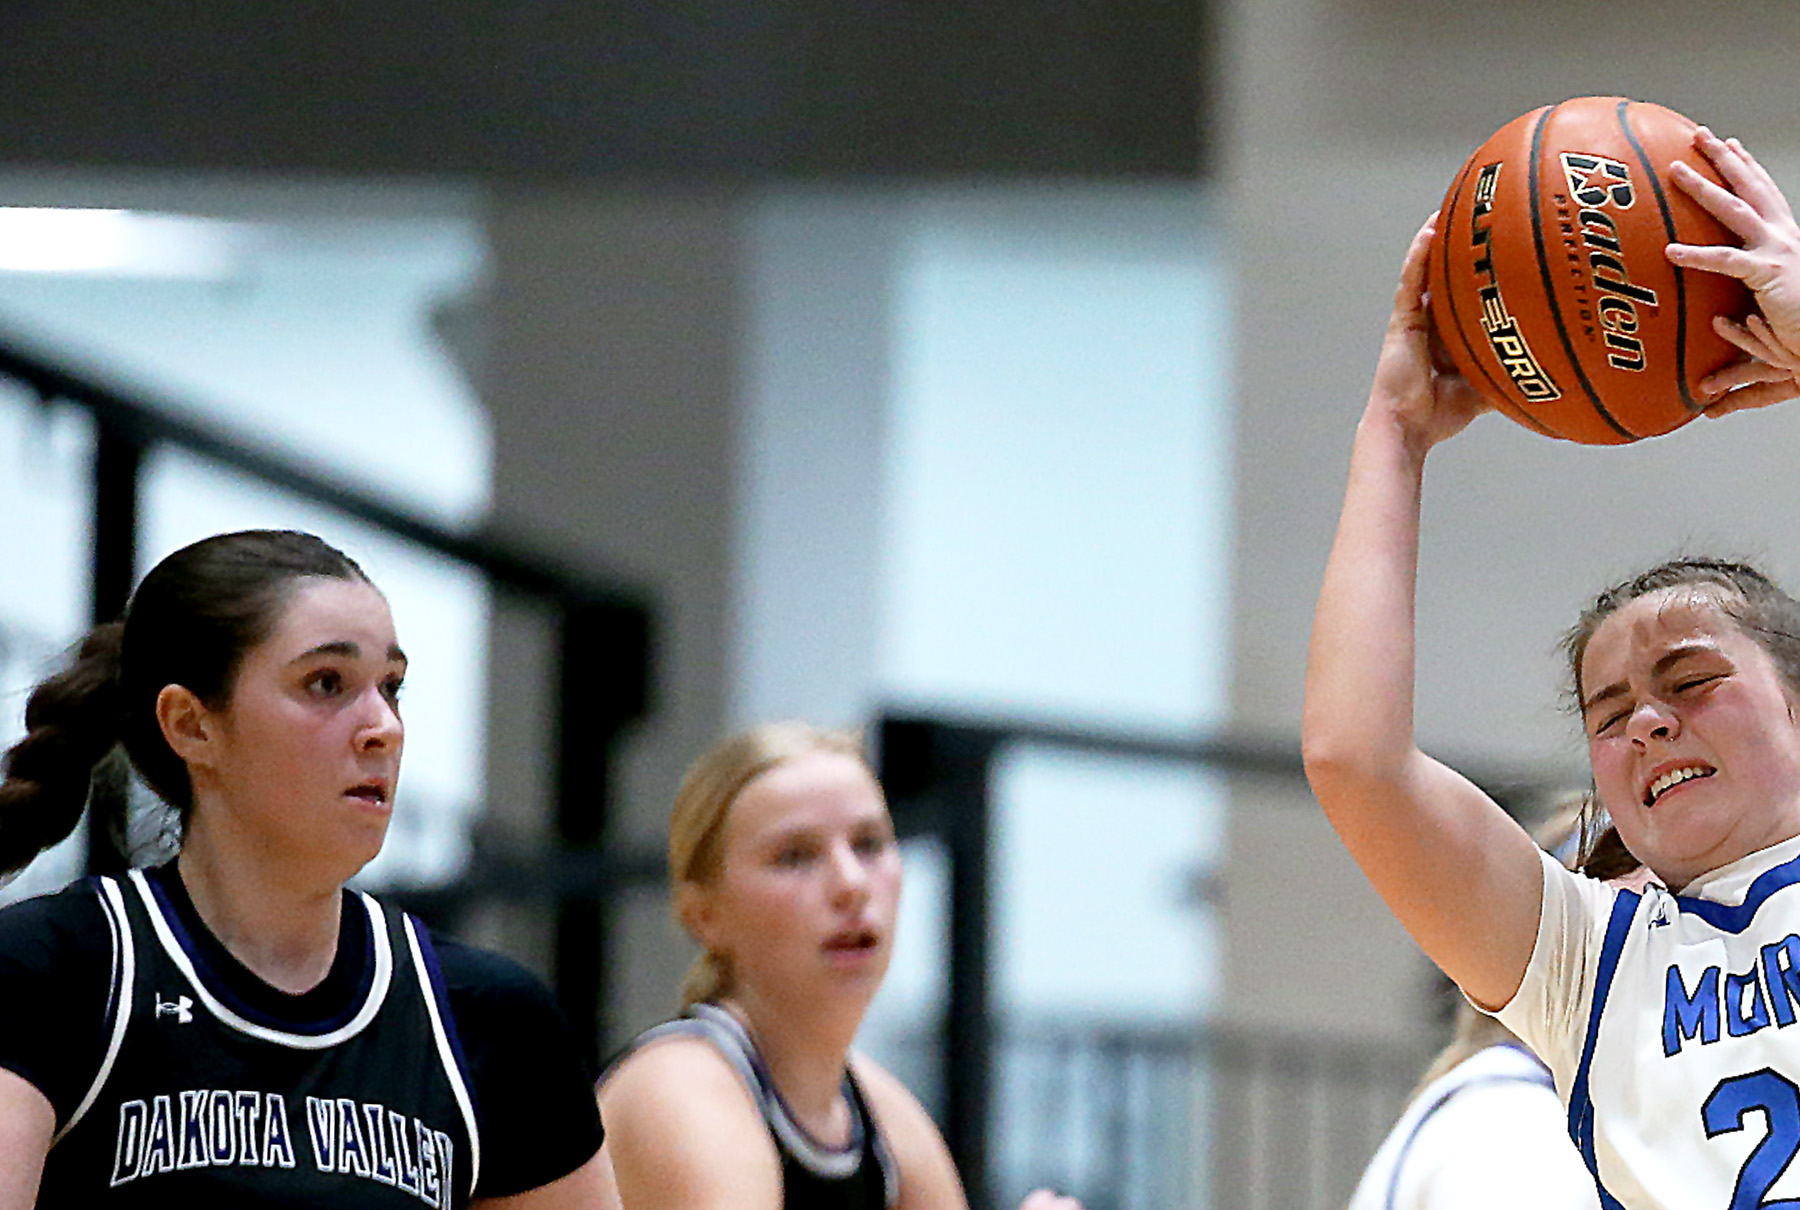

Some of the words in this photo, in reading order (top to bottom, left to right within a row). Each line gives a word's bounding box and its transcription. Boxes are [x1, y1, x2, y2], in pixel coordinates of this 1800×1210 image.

[1559, 150, 1660, 374] Baden
[1488, 328, 1557, 401] PRO
[109, 1088, 296, 1189] DAKOTA
